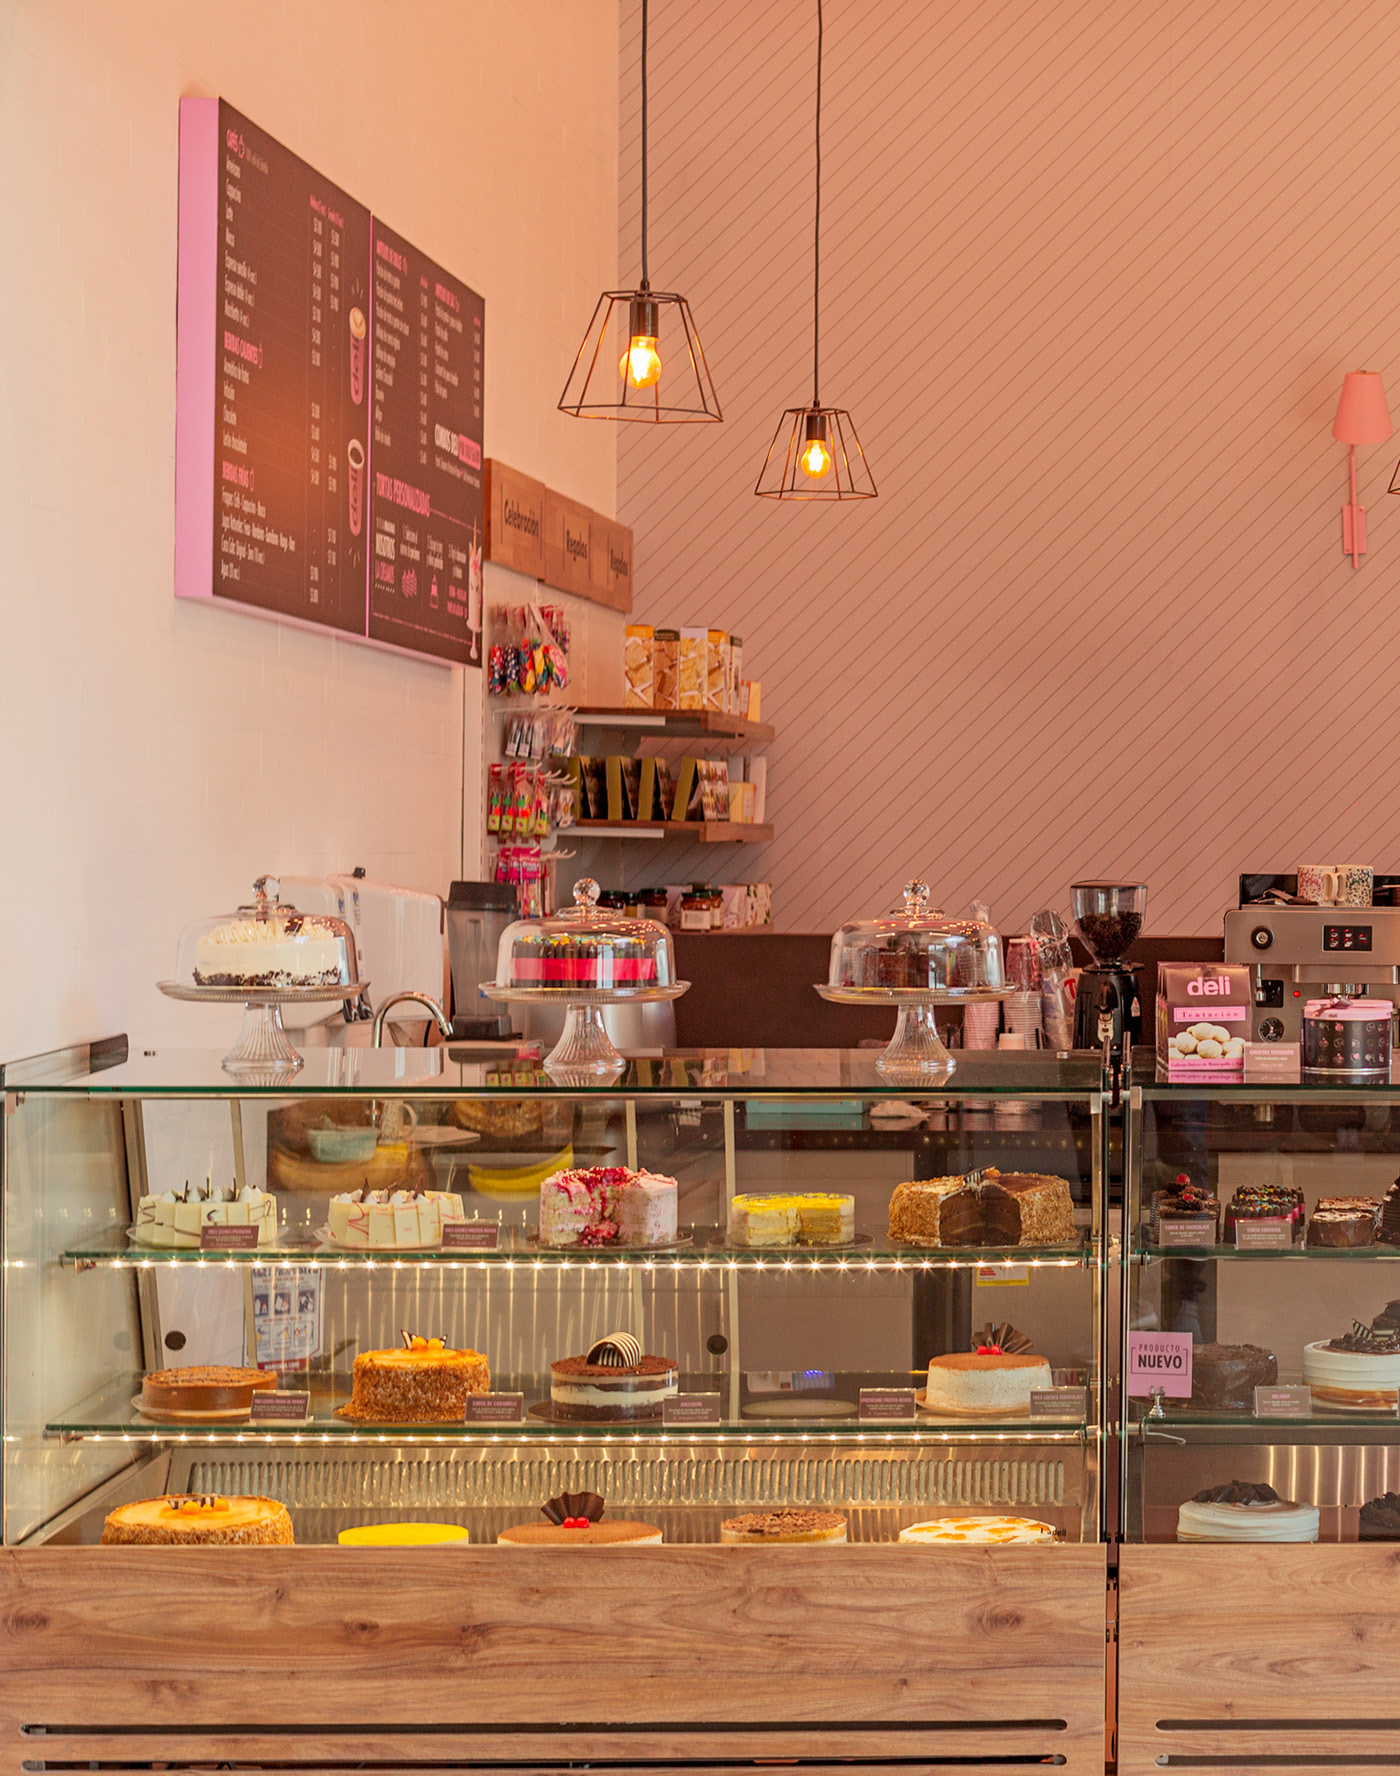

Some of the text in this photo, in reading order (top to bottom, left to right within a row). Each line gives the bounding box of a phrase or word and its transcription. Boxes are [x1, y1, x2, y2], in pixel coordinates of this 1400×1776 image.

[504, 499, 539, 537] Celebración
[567, 529, 587, 562] Regalos
[610, 547, 629, 580] Regalos
[1187, 976, 1231, 996] deli
[1182, 1010, 1239, 1019] Tentación
[1138, 1344, 1180, 1353] PRODUCTO
[1138, 1354, 1182, 1368] NUEVO
